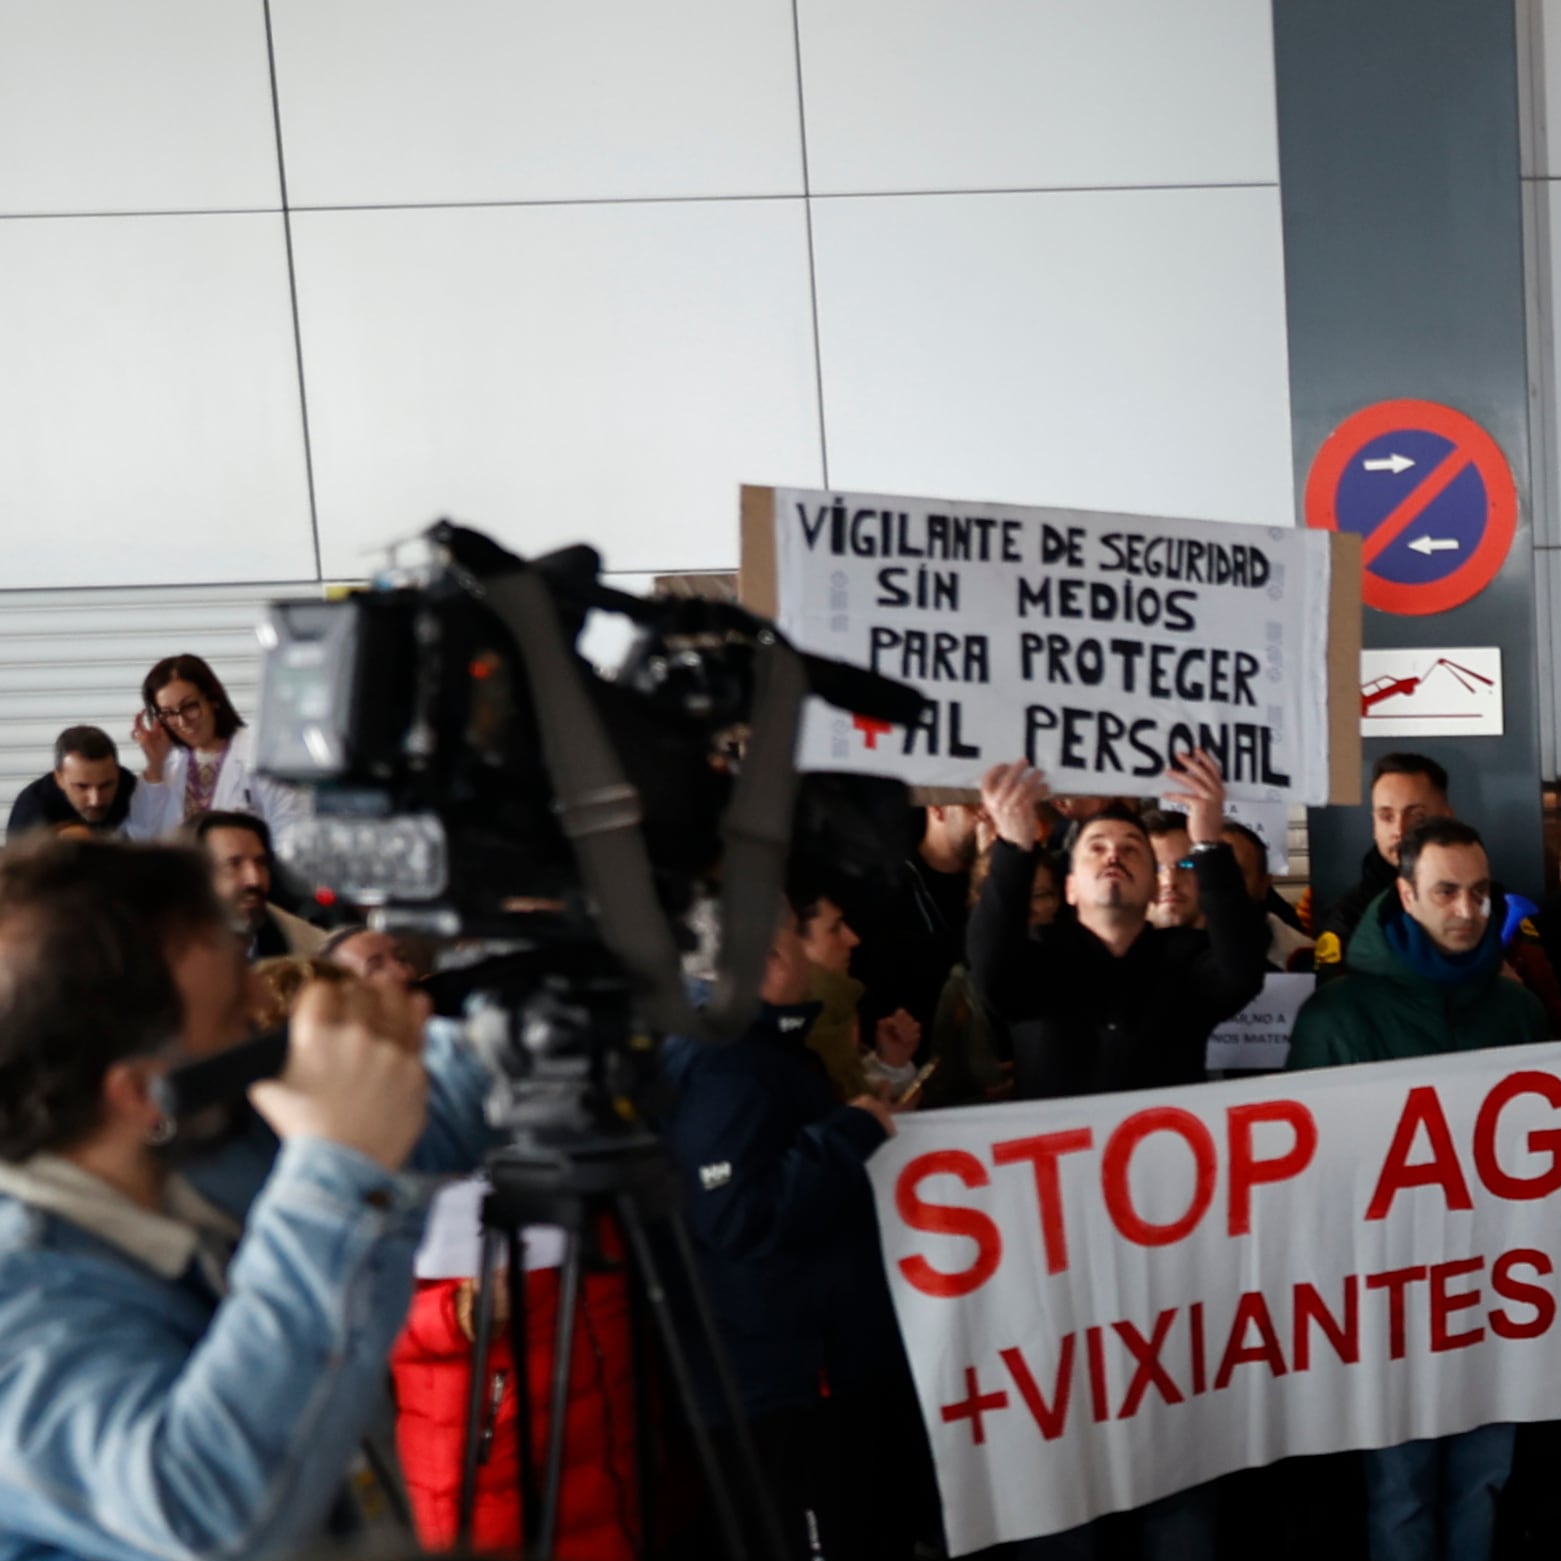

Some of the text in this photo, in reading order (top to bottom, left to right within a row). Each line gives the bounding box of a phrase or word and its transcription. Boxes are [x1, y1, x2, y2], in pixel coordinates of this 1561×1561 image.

[1041, 523, 1086, 567] DE
[1099, 533, 1270, 589] SEGURIDAD
[870, 625, 1260, 707] PARA PROTEGER
[1024, 704, 1291, 788] PERSONAL
[894, 1099, 1318, 1297] STOP
[940, 1248, 1556, 1446] +VIXIANTES
